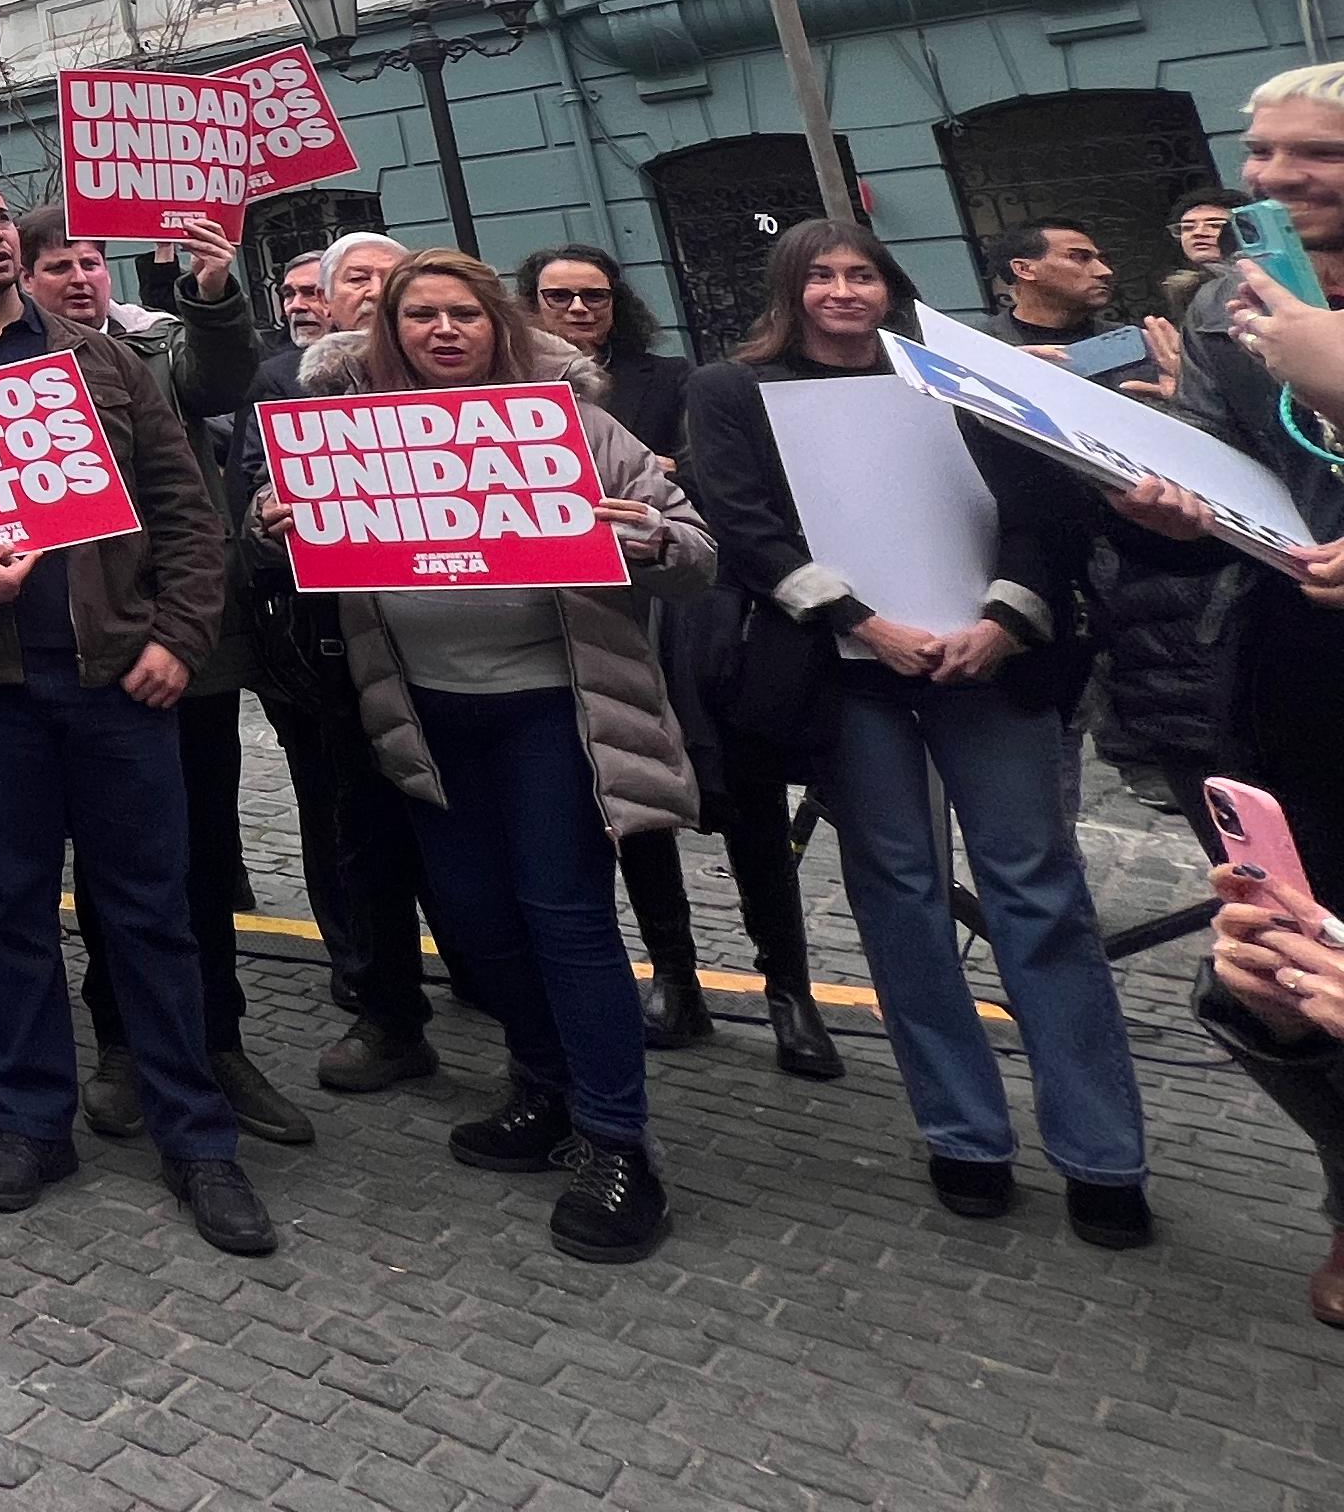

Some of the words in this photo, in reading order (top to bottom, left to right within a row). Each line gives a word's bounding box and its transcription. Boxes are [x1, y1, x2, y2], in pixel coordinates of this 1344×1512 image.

[70, 81, 248, 128] UNIDAD
[72, 121, 248, 166] UNIDAD
[75, 161, 246, 206] UNIDAD
[754, 213, 778, 235] 70
[271, 397, 568, 454] UNIDAD
[280, 444, 582, 499] UNIDAD
[292, 492, 596, 545] UNIDAD
[413, 559, 489, 574] JARA
